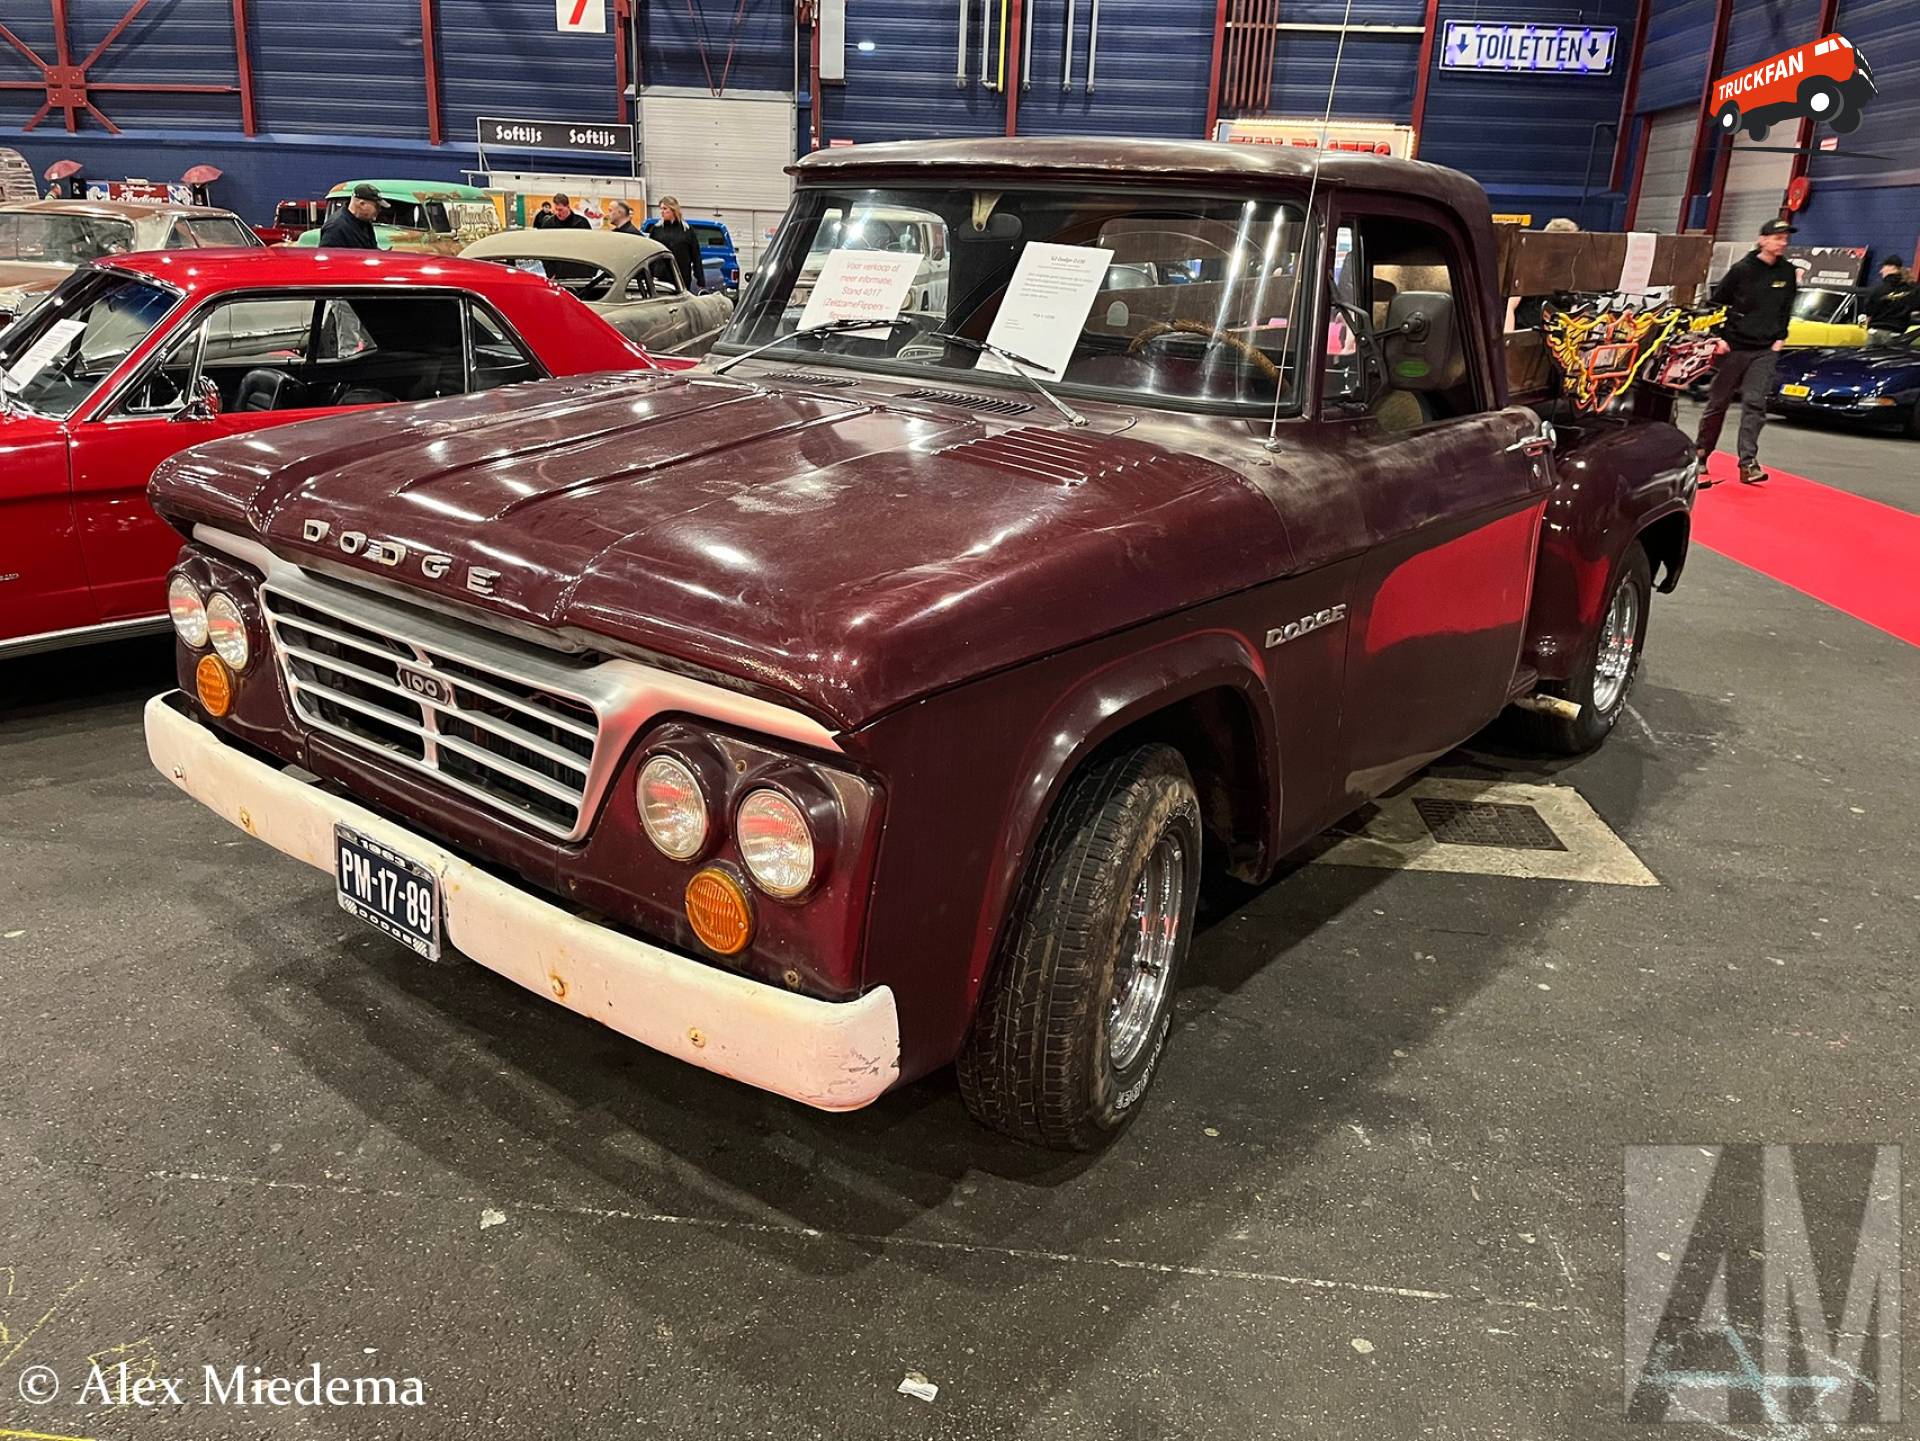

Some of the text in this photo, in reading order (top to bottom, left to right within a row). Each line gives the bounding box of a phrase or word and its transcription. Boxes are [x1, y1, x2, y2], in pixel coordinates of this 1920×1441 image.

[1476, 34, 1583, 62] TOILETTEN
[495, 125, 616, 147] Softijs Softijs
[841, 287, 862, 296] Stand
[303, 518, 501, 595] DODGE
[1265, 603, 1347, 649] DODGE
[405, 671, 438, 697] 100
[341, 847, 431, 935] PM-17-89
[358, 908, 413, 945] DODGE
